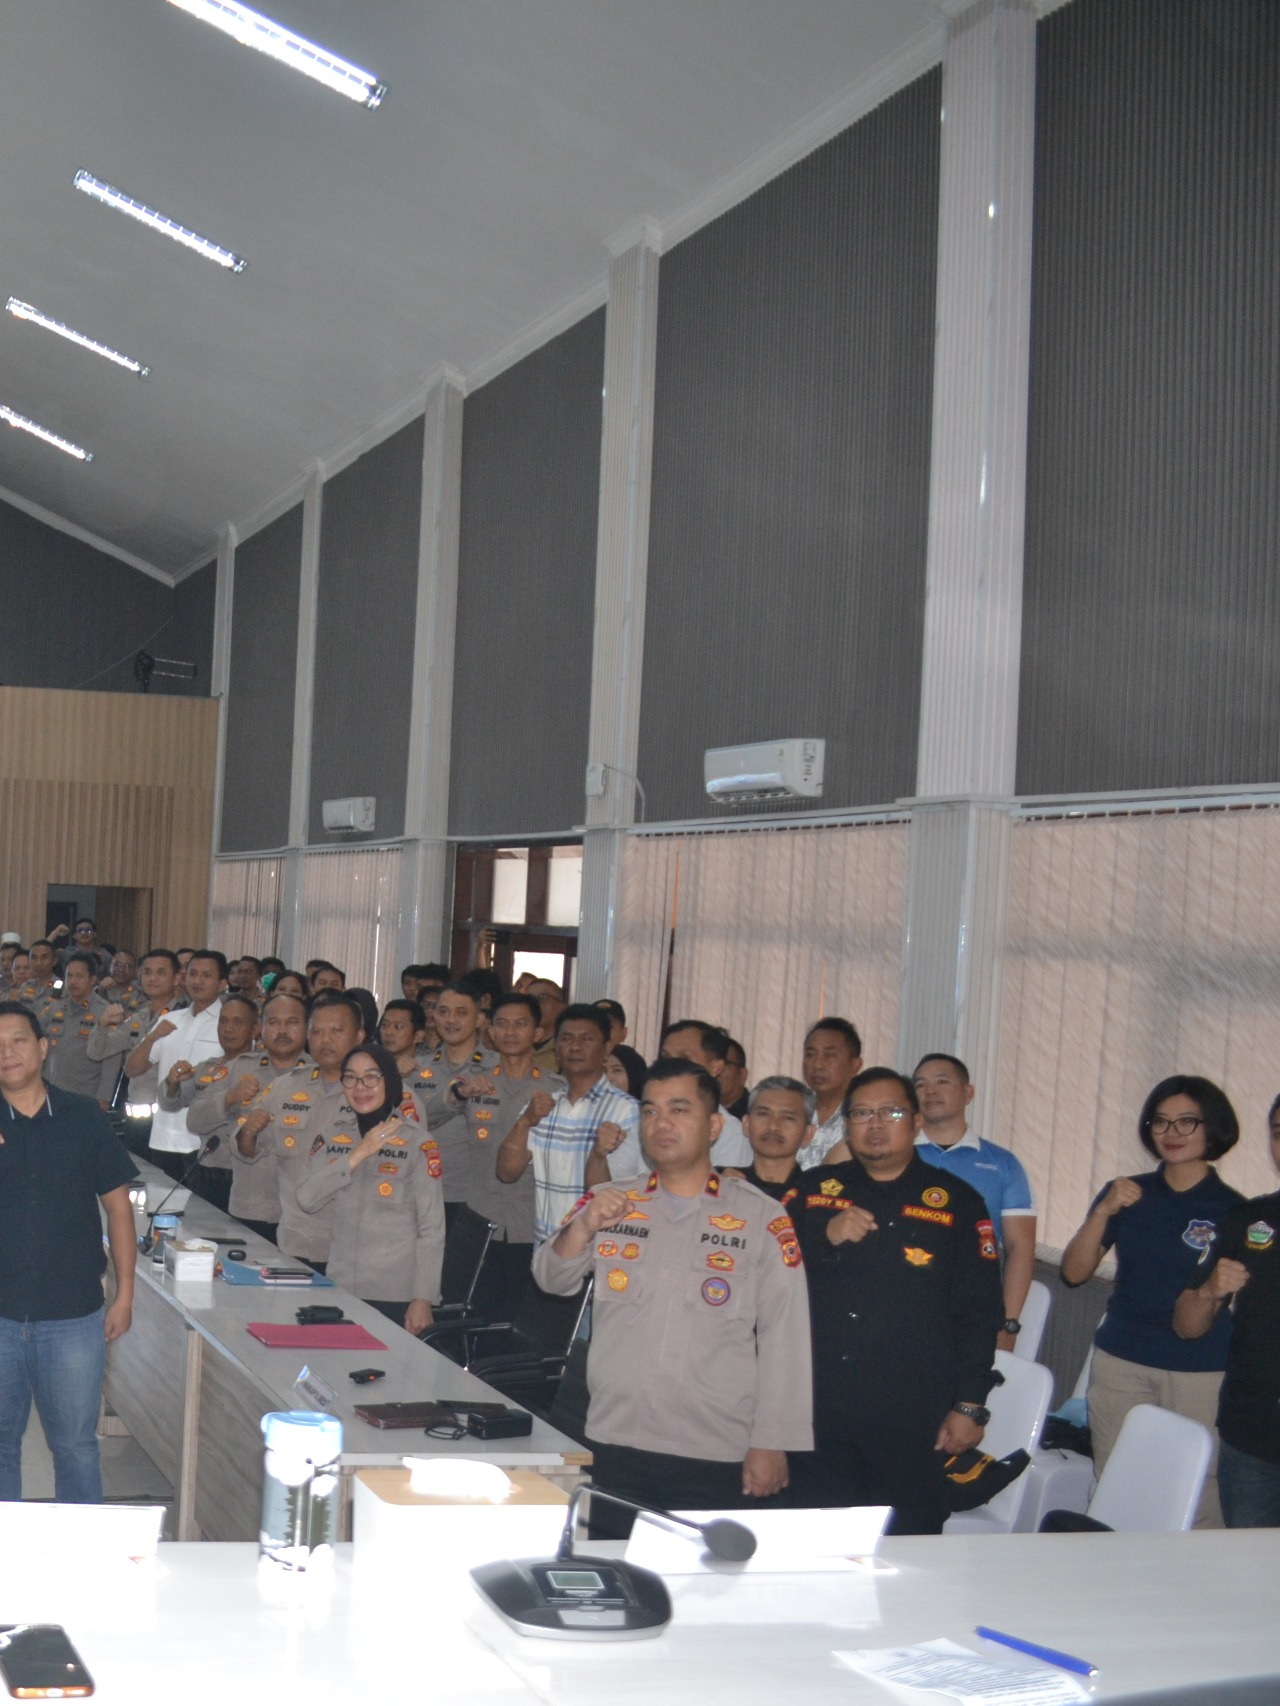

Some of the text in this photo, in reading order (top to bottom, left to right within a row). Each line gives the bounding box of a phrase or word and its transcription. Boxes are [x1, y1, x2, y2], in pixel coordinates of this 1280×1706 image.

[282, 1102, 311, 1112] DUDDY
[378, 1148, 408, 1159] POLRI
[904, 1207, 951, 1224] SENKOM
[700, 1232, 747, 1249] POLRI
